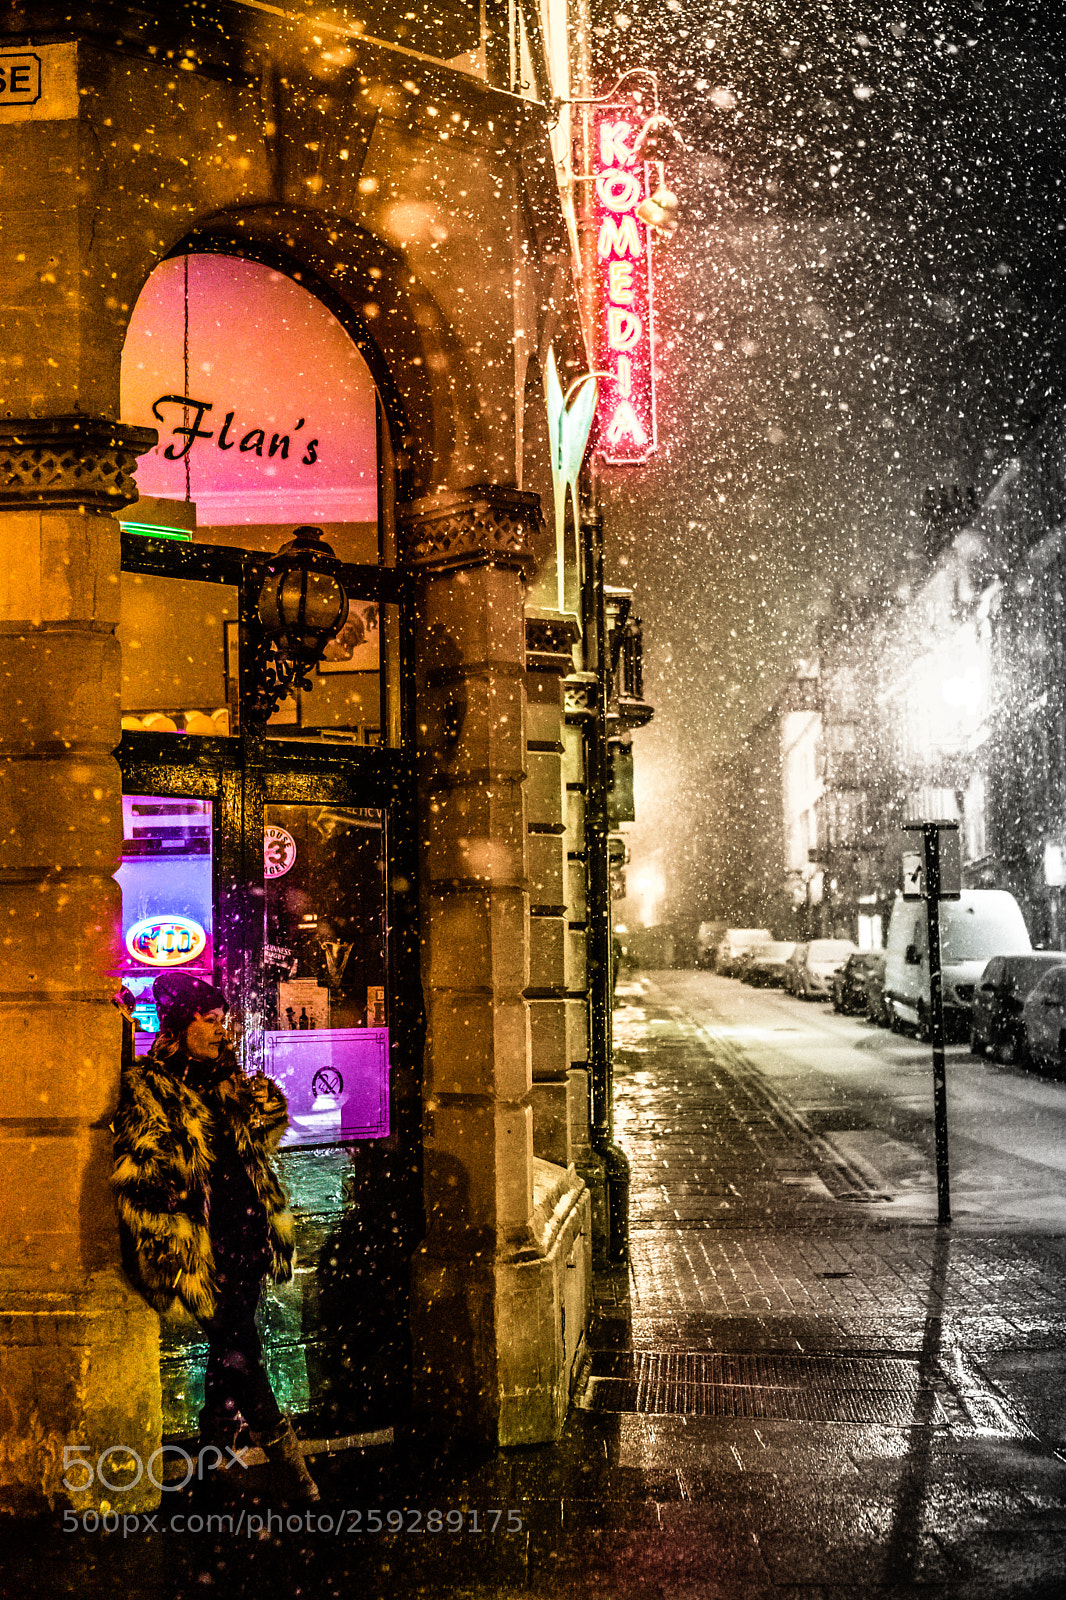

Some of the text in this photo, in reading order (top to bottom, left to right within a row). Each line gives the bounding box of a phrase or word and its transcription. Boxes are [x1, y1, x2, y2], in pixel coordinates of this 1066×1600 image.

[596, 121, 645, 445] KOMEDIA
[152, 394, 319, 465] Flan's
[264, 861, 287, 875] AGER
